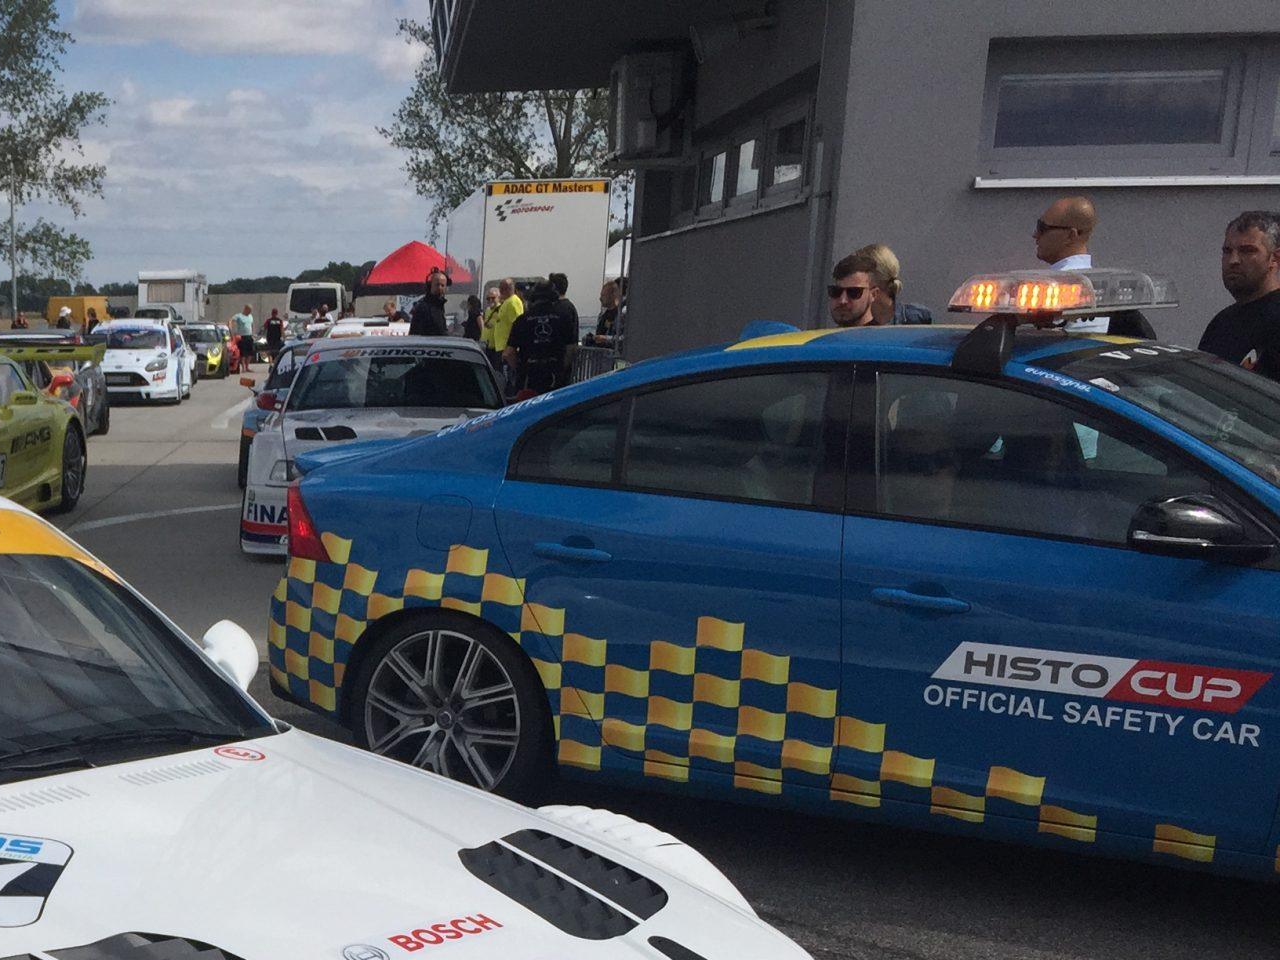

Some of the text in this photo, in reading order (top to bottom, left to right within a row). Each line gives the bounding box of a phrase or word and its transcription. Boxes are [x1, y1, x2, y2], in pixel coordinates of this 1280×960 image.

[503, 182, 594, 194] ADAC GT Masters
[1024, 367, 1092, 393] eurosignal
[436, 392, 554, 437] eurosignal
[24, 425, 51, 449] AMG
[247, 501, 288, 523] FINA
[963, 650, 1242, 703] HISTO CUP
[923, 684, 1262, 748] OFFICIAL SAFETY CAR
[387, 913, 504, 953] BOSCH
